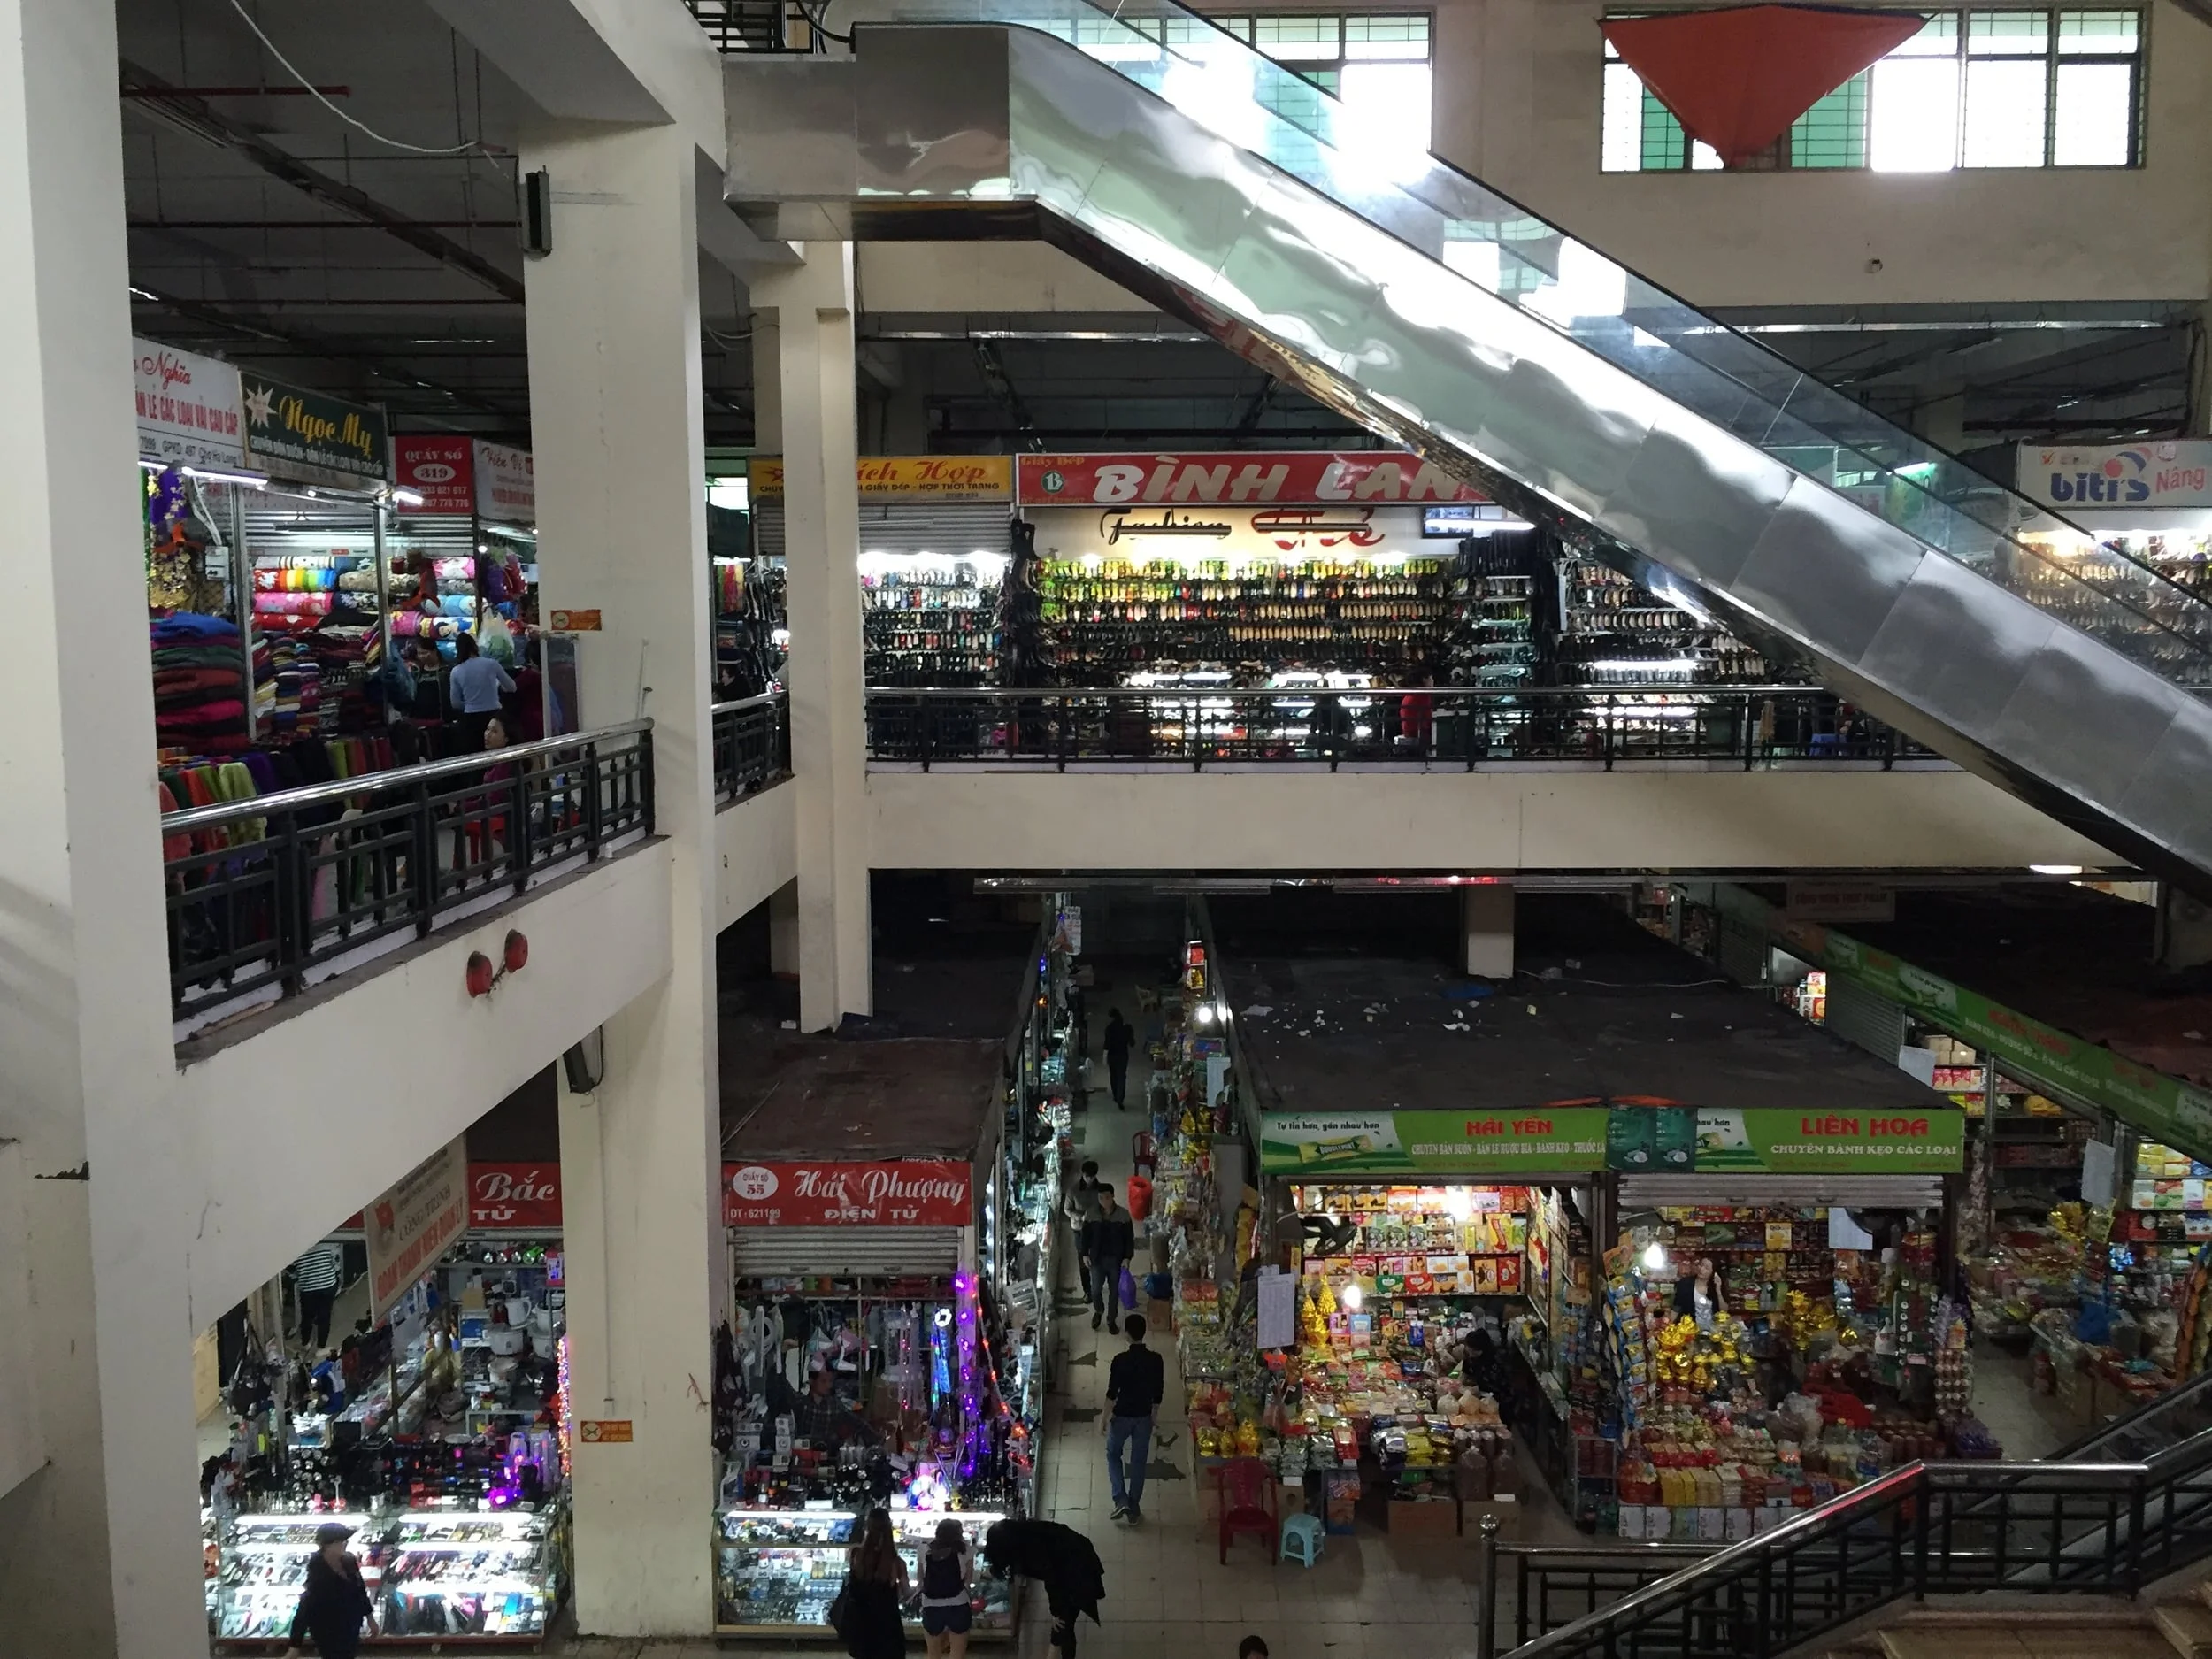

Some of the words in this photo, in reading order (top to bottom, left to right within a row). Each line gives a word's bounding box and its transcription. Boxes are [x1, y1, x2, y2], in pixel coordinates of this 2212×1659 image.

[279, 395, 337, 446] Ngọc
[857, 460, 897, 481] ích
[913, 461, 988, 484] Hợp
[1093, 456, 1290, 503] BÌNH
[1315, 462, 1462, 501] LAN
[1289, 1121, 1300, 1130] tin
[1340, 1121, 1361, 1130] nhau
[1364, 1121, 1379, 1130] hơn
[1466, 1117, 1504, 1136] HẢI
[1801, 1114, 1859, 1136] LIÊN
[1870, 1118, 1929, 1138] HOA
[1770, 1142, 1824, 1155] CHUYÊN
[1827, 1142, 1863, 1155] BÁNH
[1866, 1145, 1893, 1156] KẸO
[1896, 1142, 1924, 1155] CÁC
[1926, 1145, 1957, 1157] LOẠI
[476, 1171, 555, 1201] Bắc
[747, 1184, 764, 1194] 55
[862, 1169, 966, 1206] Phượng
[472, 1205, 517, 1220] TỬ
[824, 1204, 876, 1222] ĐIỆN
[890, 1204, 920, 1219] TỬ
